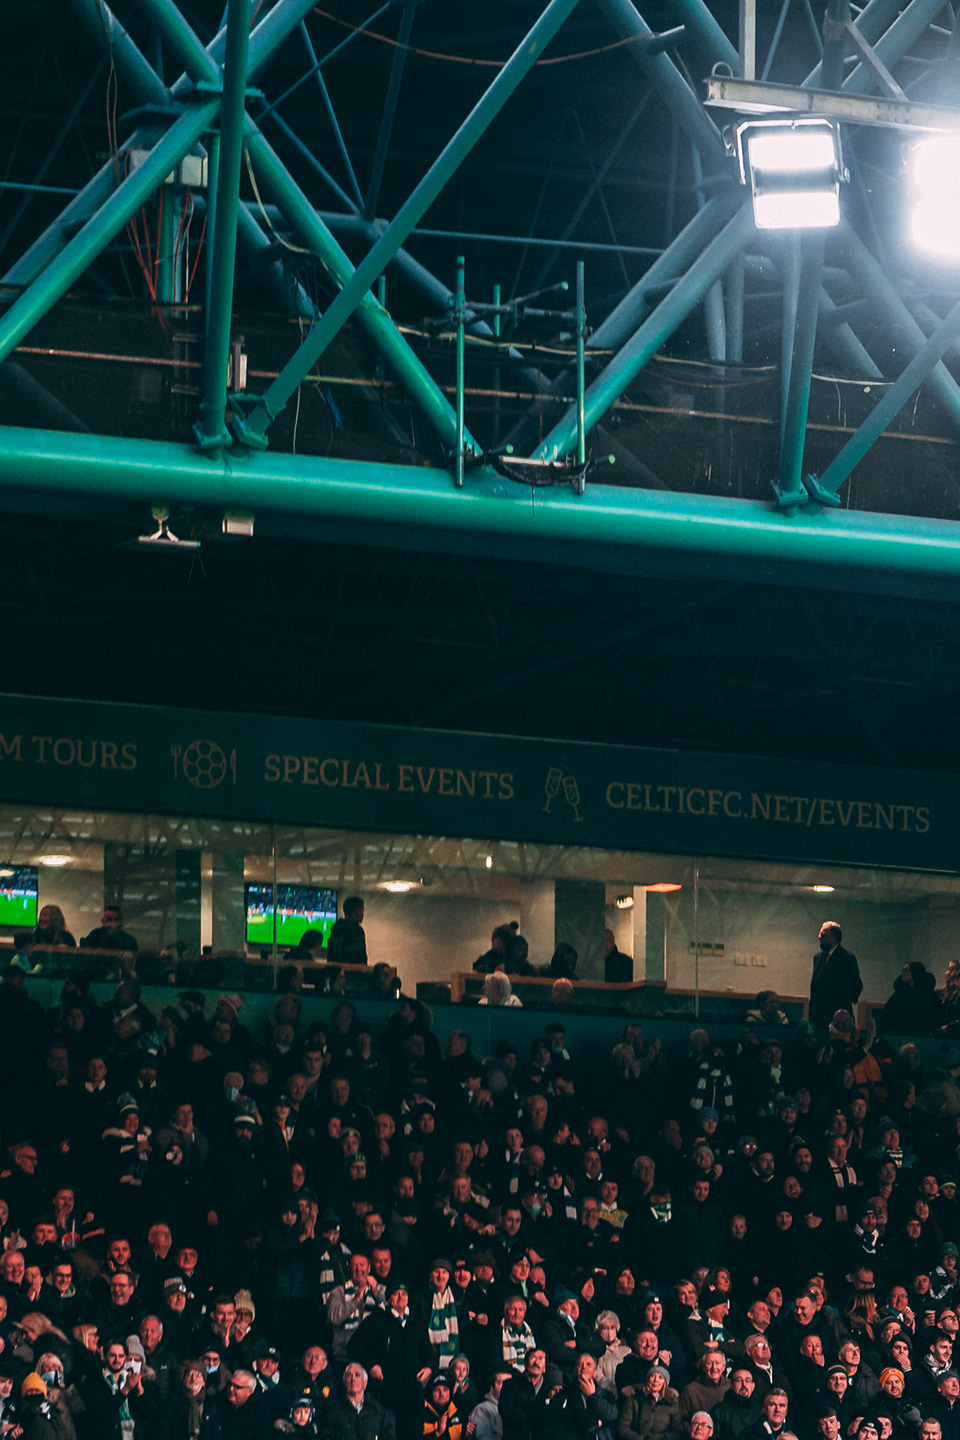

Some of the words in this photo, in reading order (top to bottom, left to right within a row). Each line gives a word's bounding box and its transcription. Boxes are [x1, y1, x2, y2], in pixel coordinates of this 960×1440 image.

[32, 737, 138, 772] TOURS
[264, 754, 389, 790] SPECIAL
[398, 764, 515, 801] EVENTS
[605, 780, 931, 834] CELTICFC.NET/EVENTS
